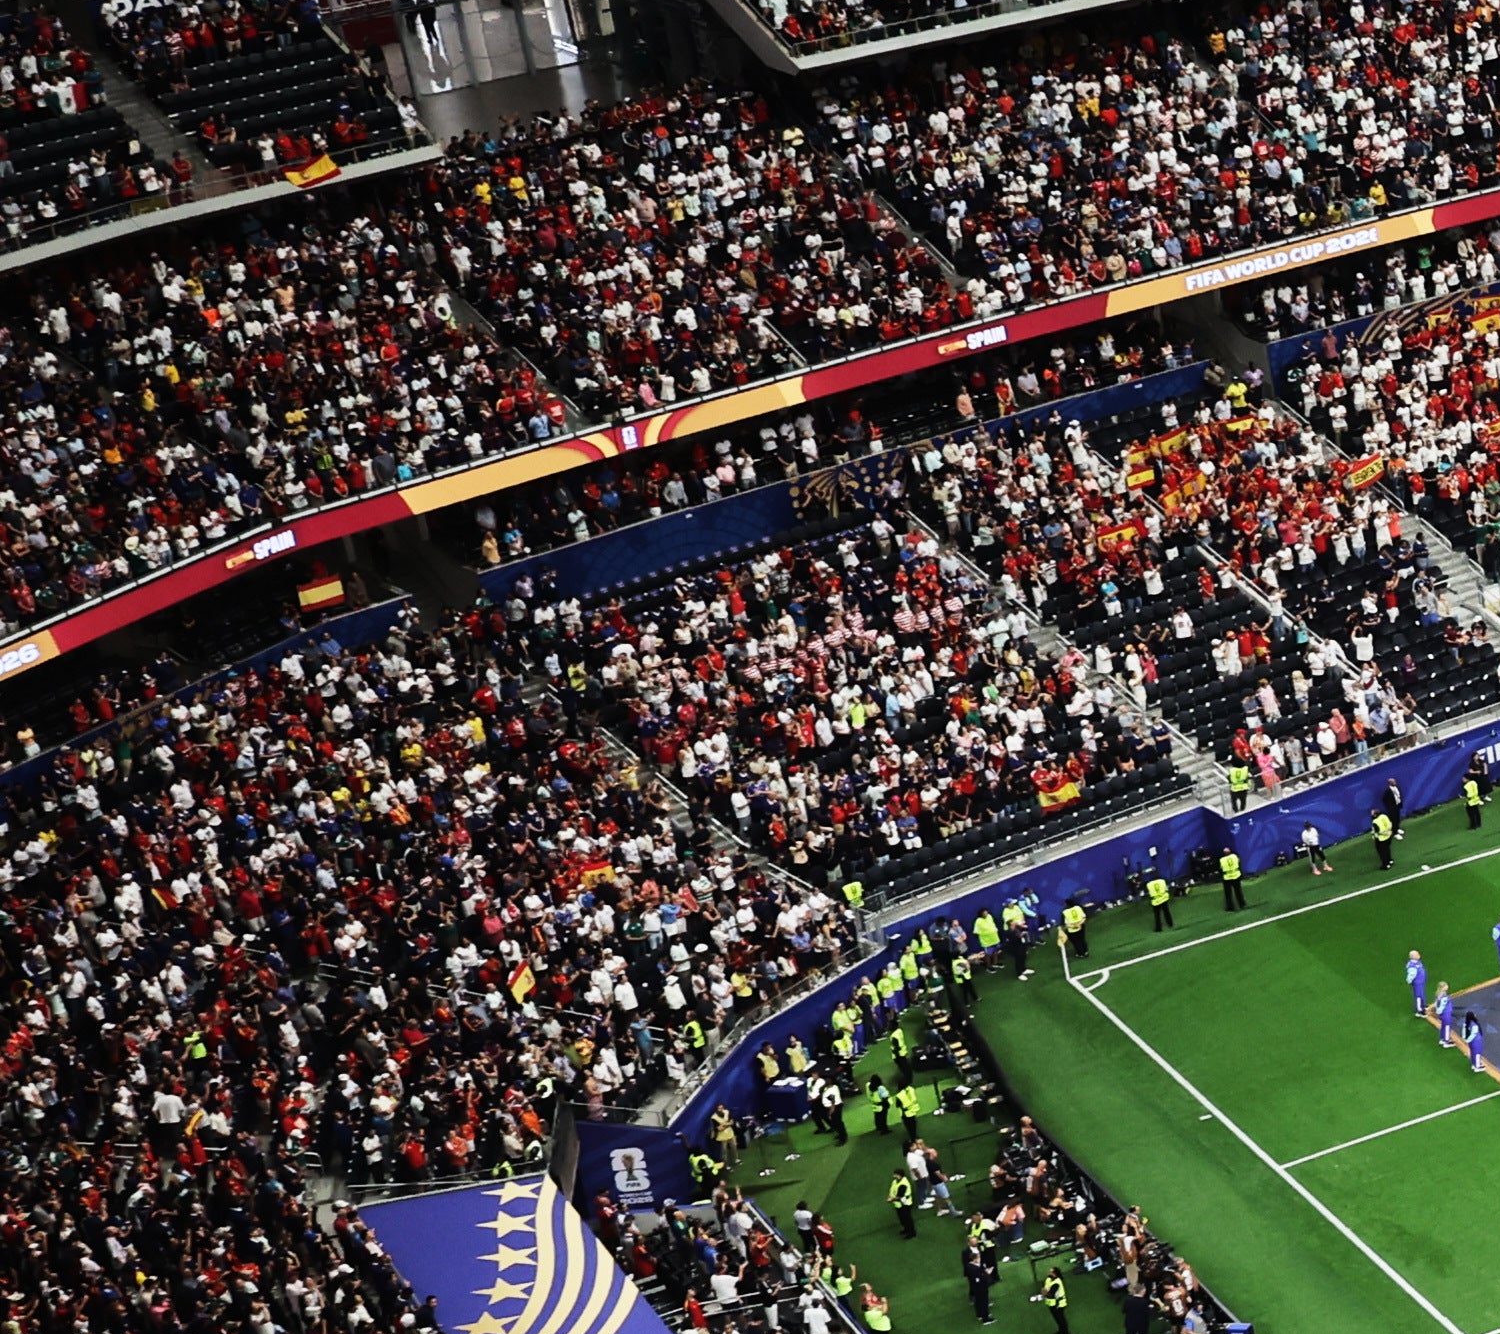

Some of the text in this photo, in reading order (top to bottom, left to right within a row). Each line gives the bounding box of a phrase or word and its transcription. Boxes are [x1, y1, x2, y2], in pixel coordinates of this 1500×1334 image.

[1184, 268, 1224, 291] FIFA
[1223, 252, 1291, 281] WORLD
[1291, 242, 1327, 263] CUP
[966, 325, 1007, 350] SPAIN
[253, 529, 296, 560] SPAIN
[0, 643, 41, 673] 26
